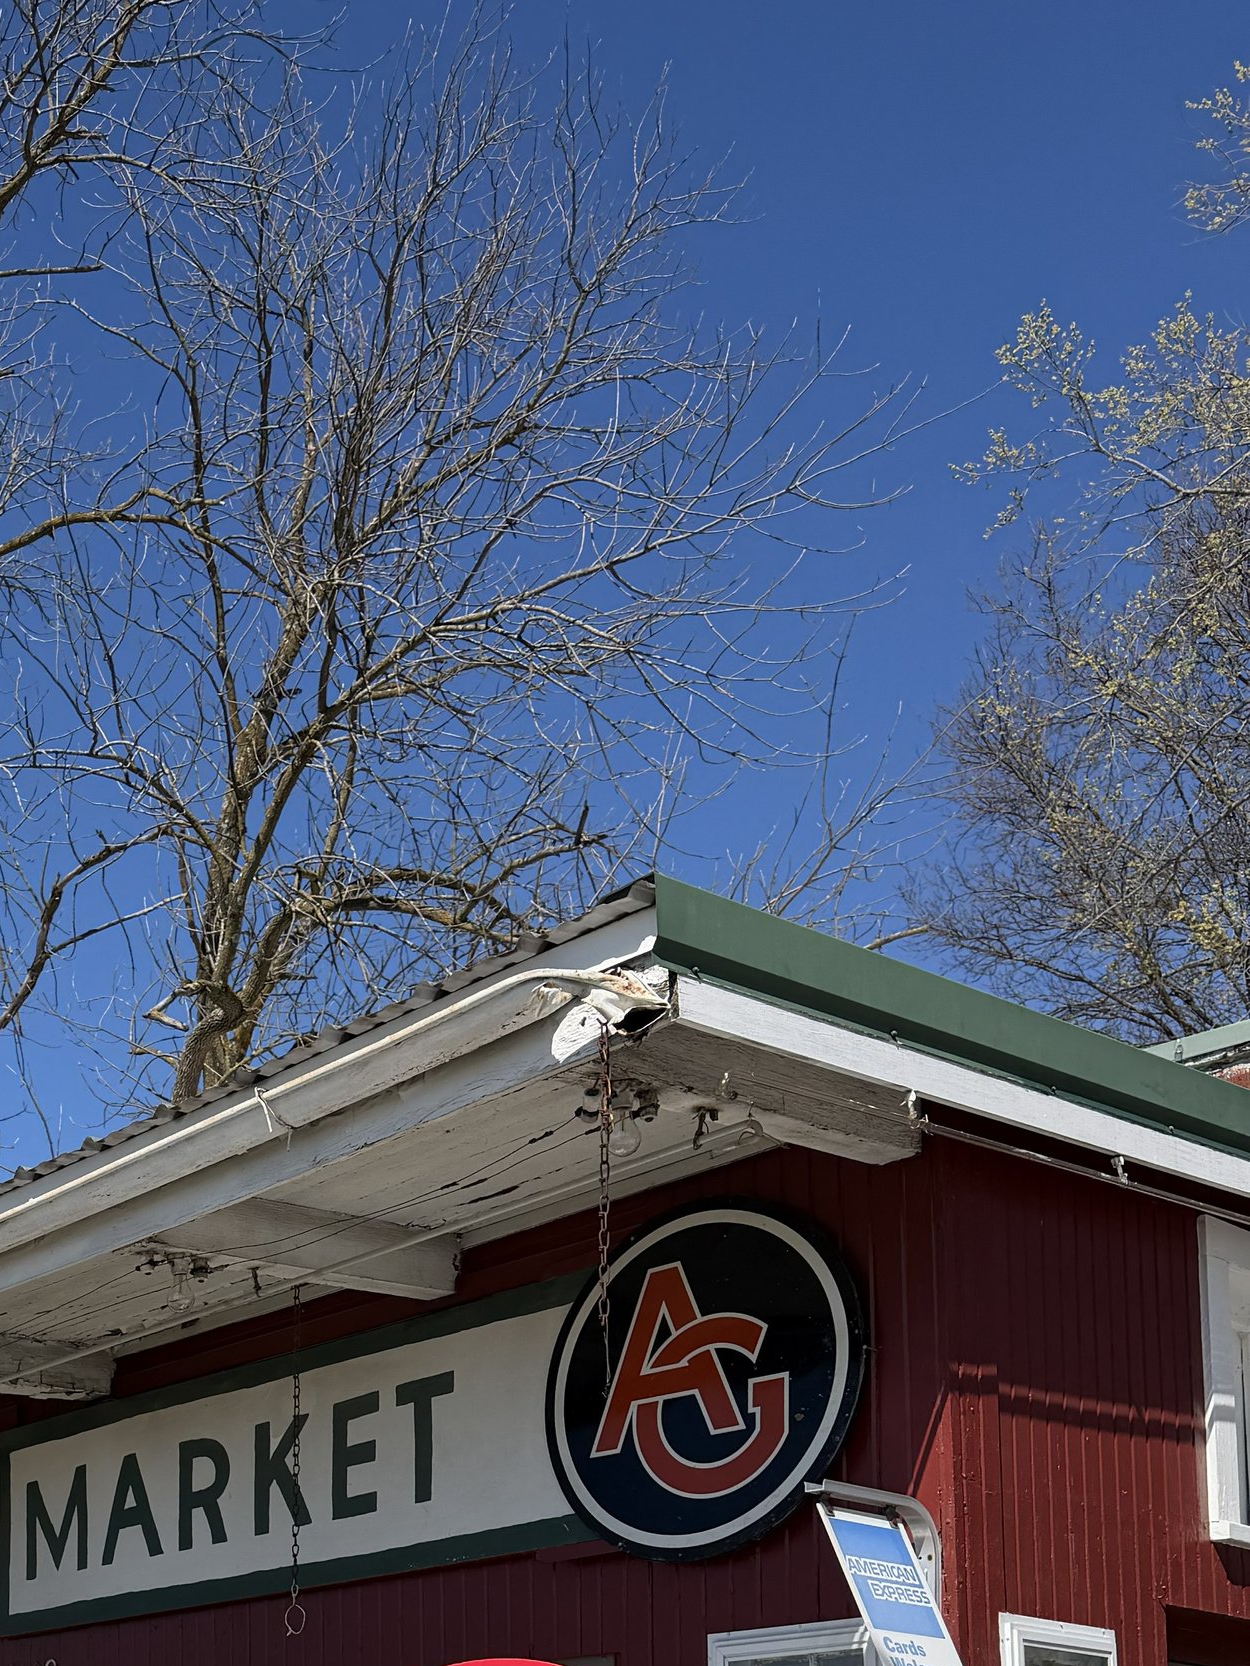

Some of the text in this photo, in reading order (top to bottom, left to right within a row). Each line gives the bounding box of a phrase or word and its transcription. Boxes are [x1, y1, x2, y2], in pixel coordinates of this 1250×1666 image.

[25, 1370, 456, 1582] MARKET
[849, 1557, 917, 1582] AMERICAN
[872, 1582, 931, 1605] EXPRESS
[882, 1635, 926, 1658] Cards
